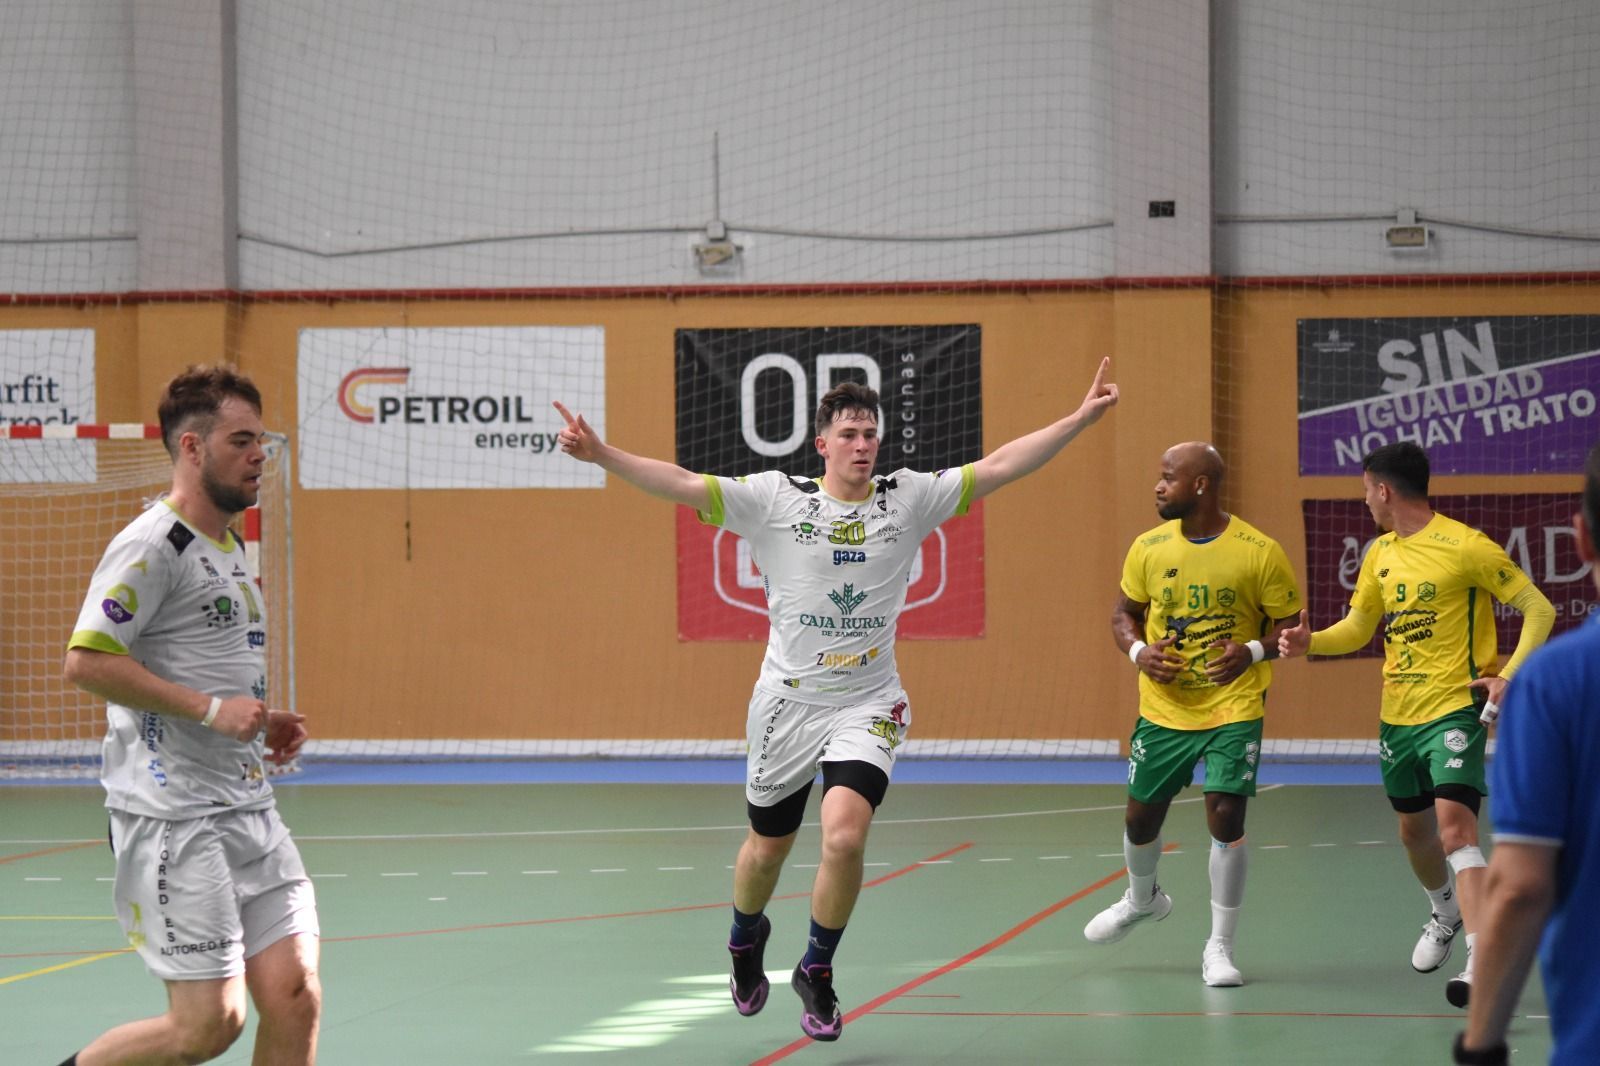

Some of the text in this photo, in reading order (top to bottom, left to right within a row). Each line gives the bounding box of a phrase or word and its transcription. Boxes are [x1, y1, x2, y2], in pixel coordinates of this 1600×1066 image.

[1377, 321, 1499, 393] SIN
[0, 374, 60, 404] rfit
[1353, 368, 1543, 432] IGUALDAD
[379, 396, 533, 424] PETROIL
[902, 352, 915, 454] cocinas
[1397, 413, 1466, 450] HAY
[1474, 389, 1597, 437] TRATO
[475, 432, 559, 454] energy
[828, 520, 866, 546] 30
[833, 550, 866, 566] gaza
[1187, 584, 1208, 609] 31
[1396, 583, 1406, 602] 9
[1571, 599, 1600, 616] De
[799, 613, 888, 629] CAJA RURAL
[1402, 629, 1433, 645] JUMBO
[816, 652, 868, 668] ZAMORA
[868, 716, 901, 750] 30
[158, 820, 176, 943] UTORED.ES
